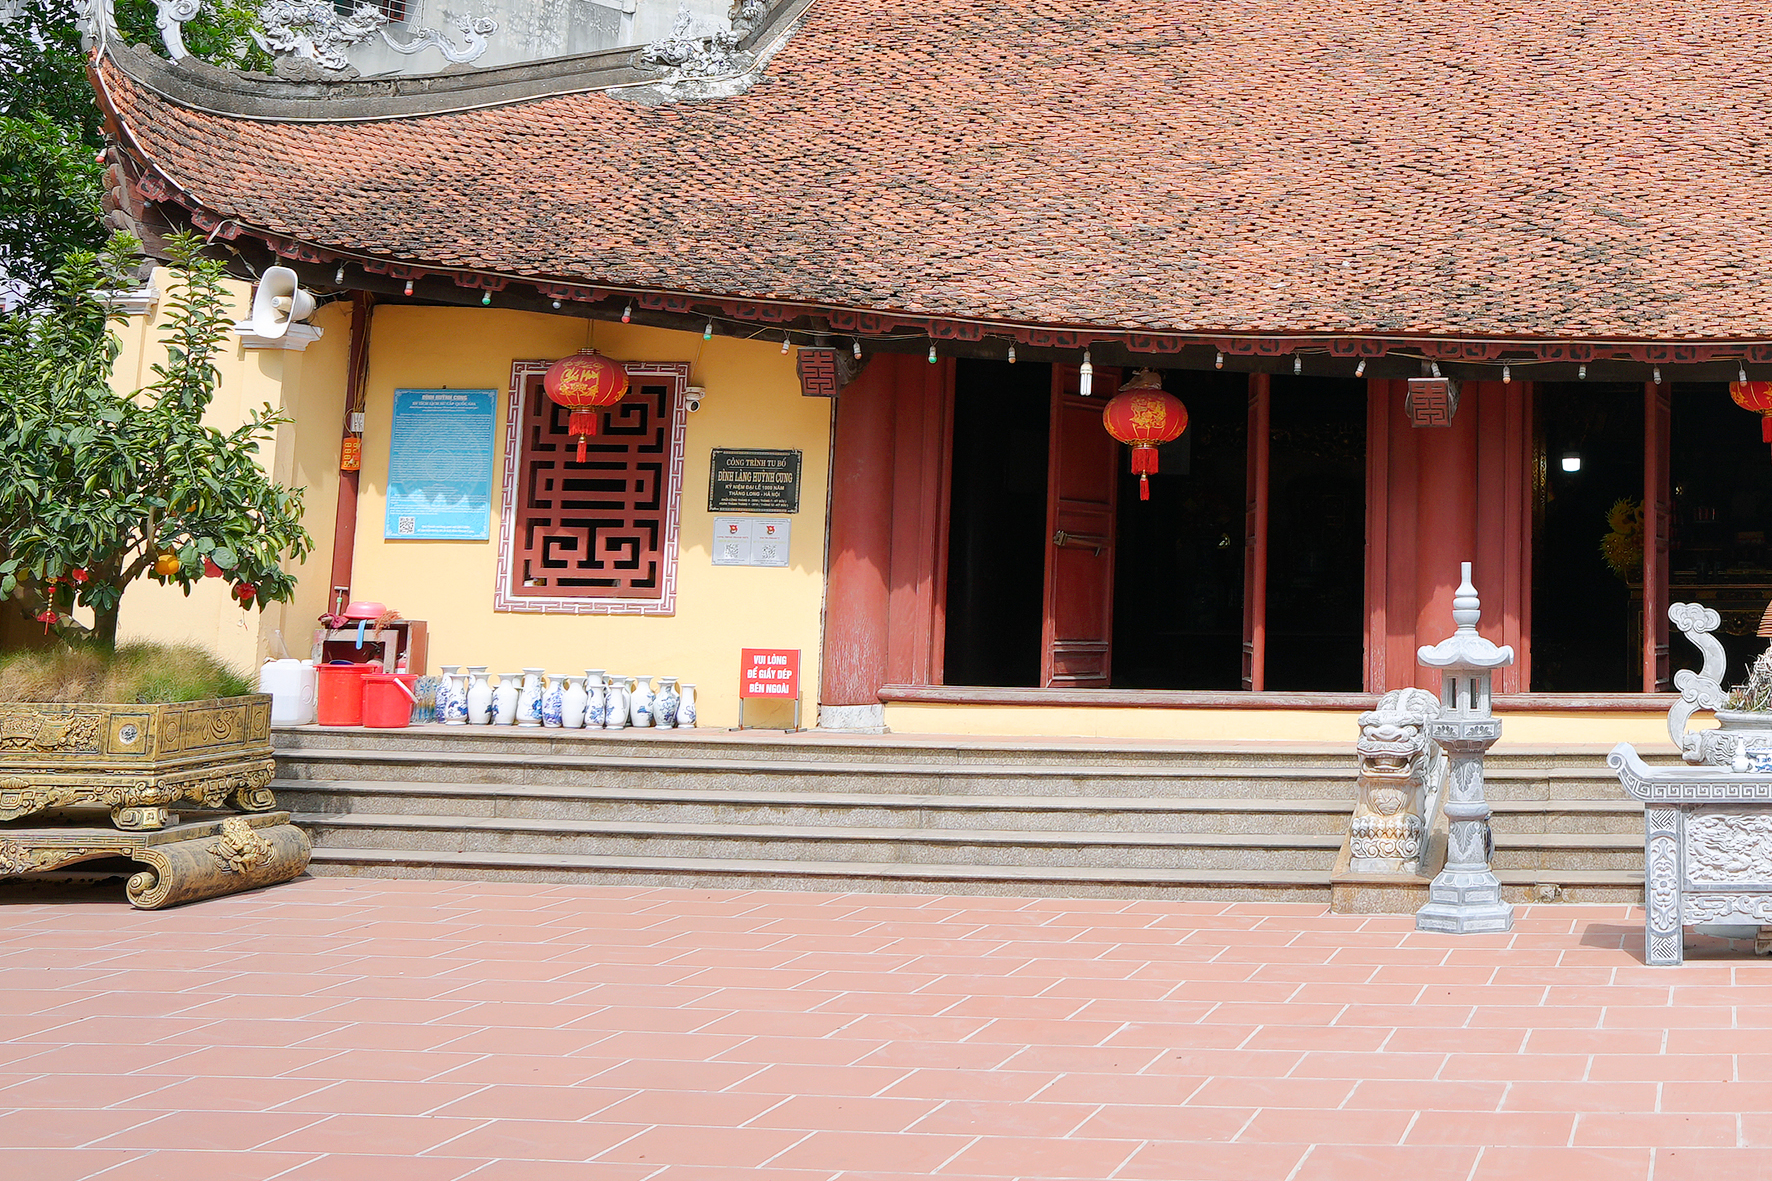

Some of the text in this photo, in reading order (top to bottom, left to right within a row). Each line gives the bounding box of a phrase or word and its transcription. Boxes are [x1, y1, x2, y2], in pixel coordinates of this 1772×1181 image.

[745, 458, 766, 467] TRÌNH
[767, 459, 777, 467] TU
[717, 468, 793, 483] ĐÌNH LÀNG HUỲNH CUNG
[753, 653, 787, 665] VUI LÒNG
[777, 668, 793, 679] DÉP
[749, 682, 789, 694] BÊN NGOÀI
